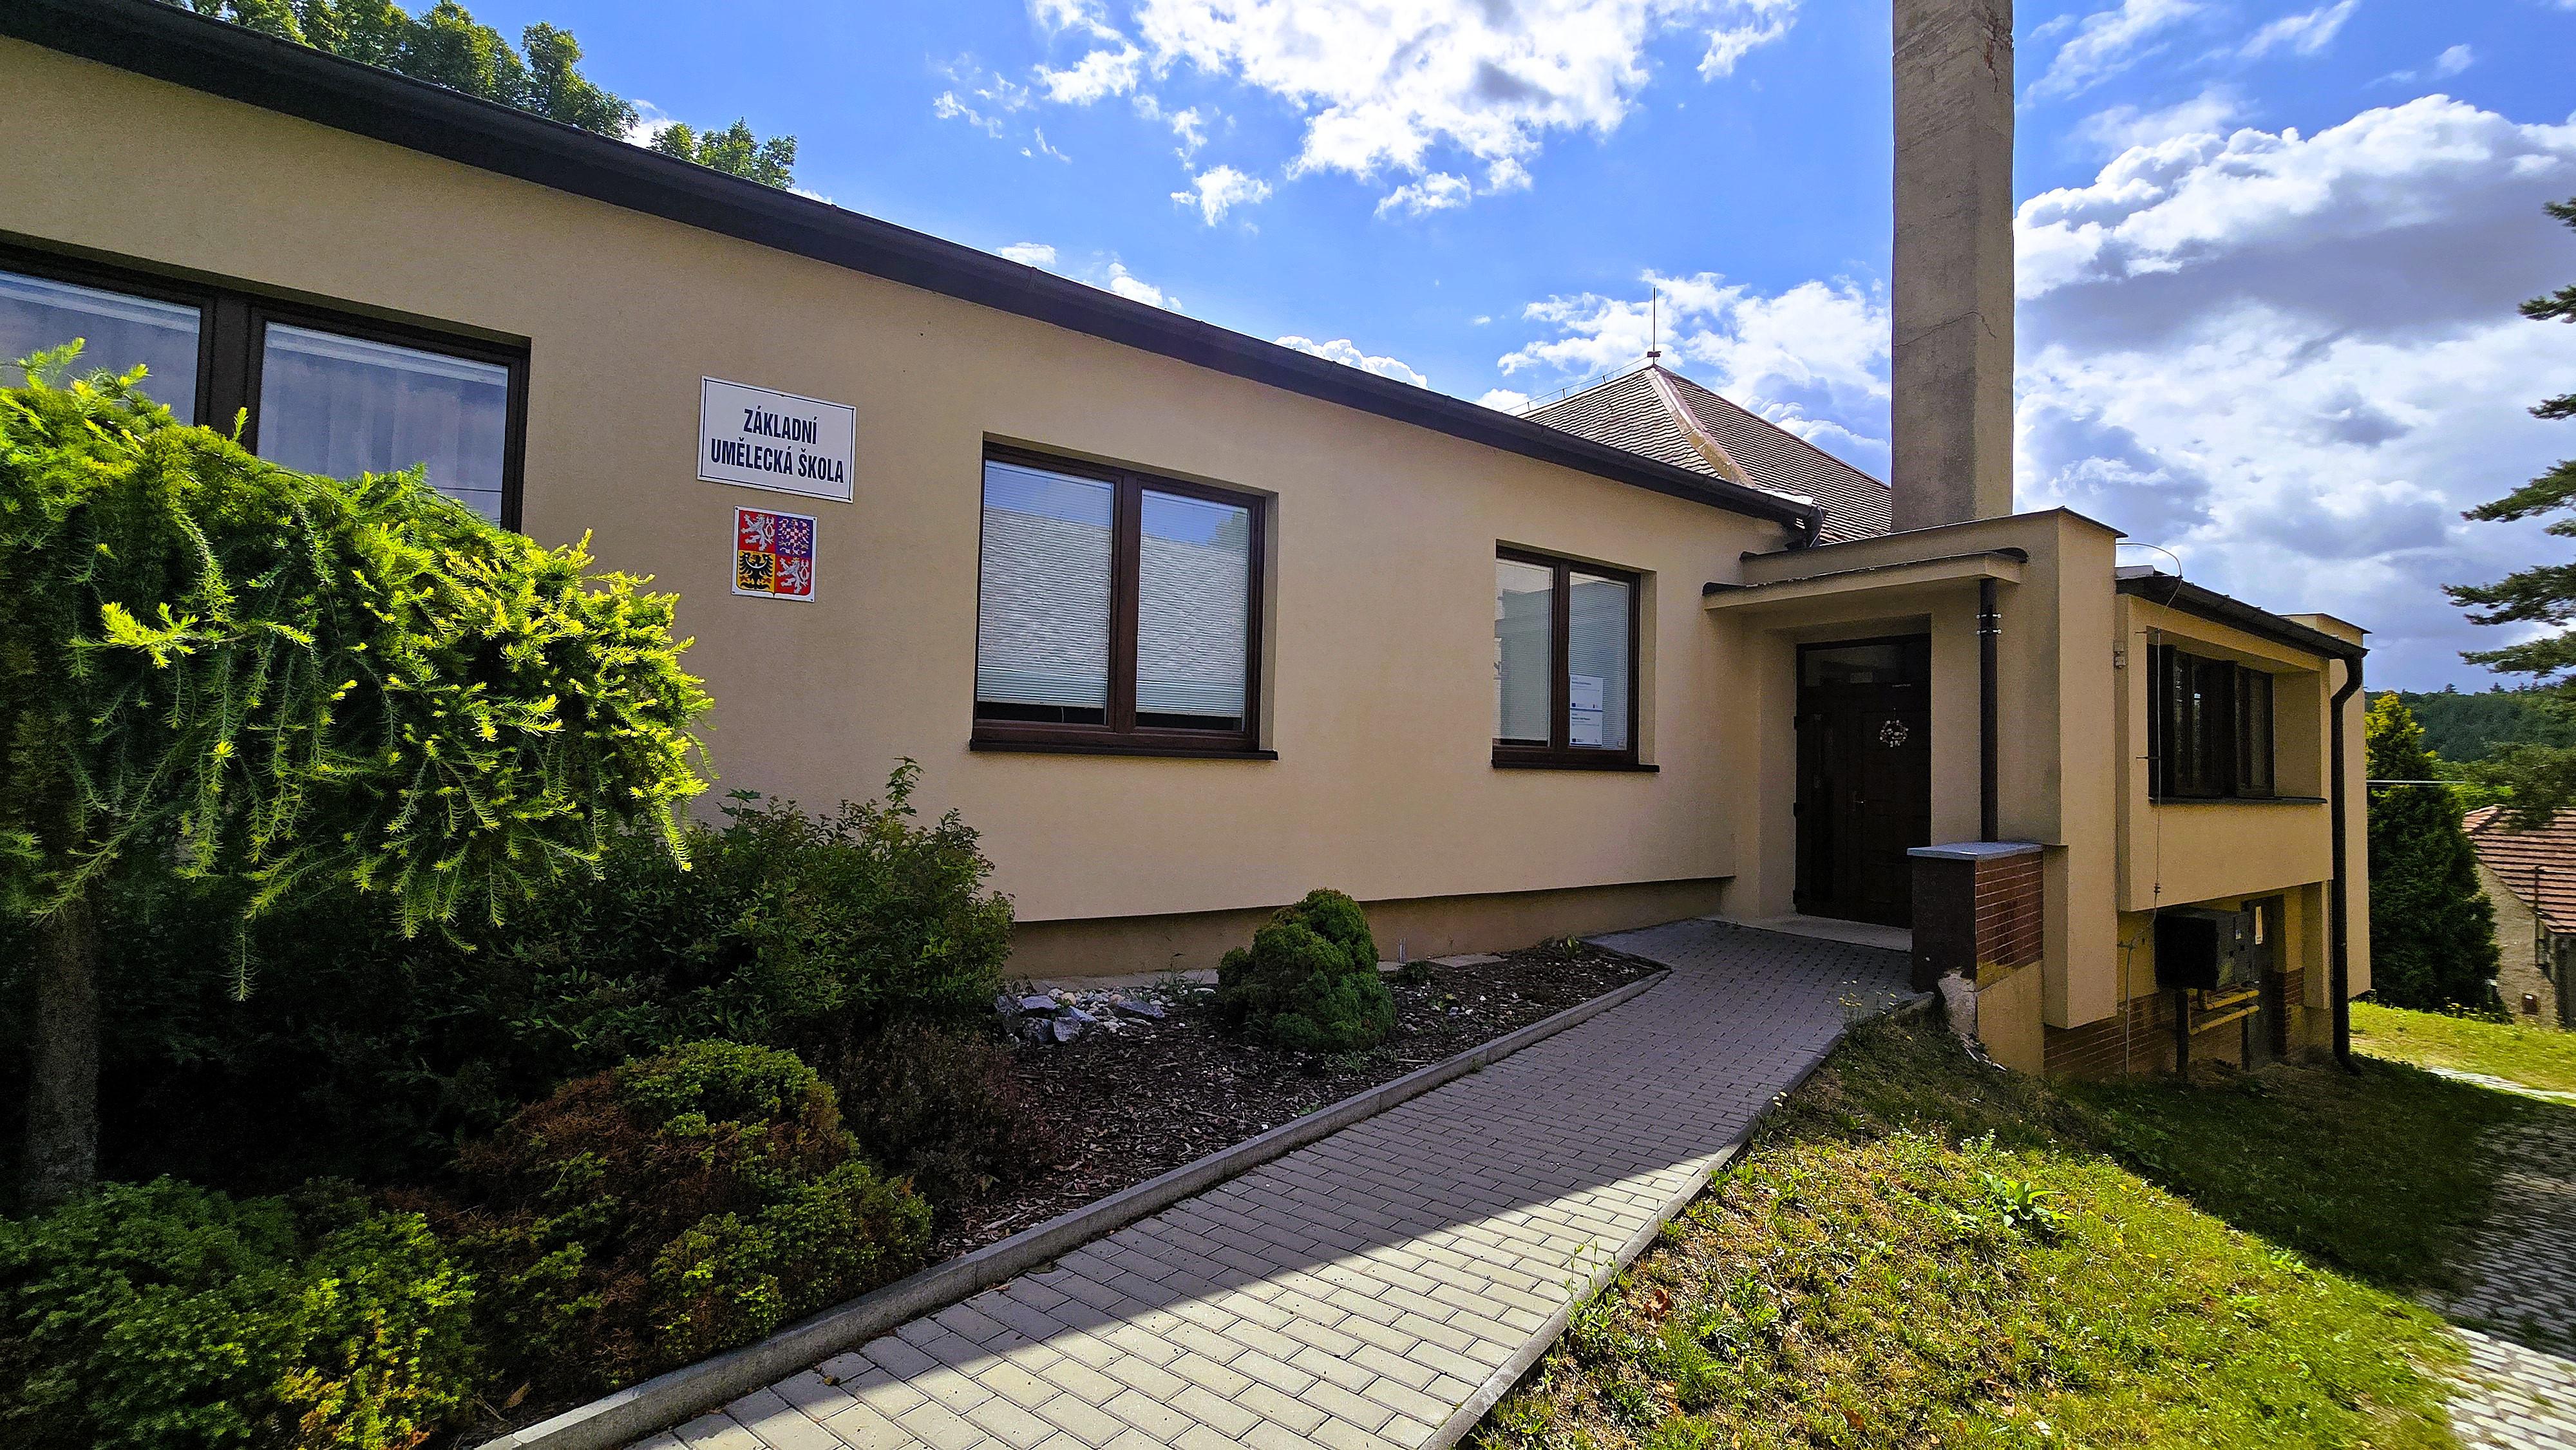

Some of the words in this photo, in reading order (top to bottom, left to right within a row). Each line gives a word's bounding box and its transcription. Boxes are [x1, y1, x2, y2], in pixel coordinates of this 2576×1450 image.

[743, 405, 818, 445] ZÁKLADNÍ
[711, 437, 793, 475] UMĚLECKÁ
[797, 447, 844, 484] ŠKOLA
